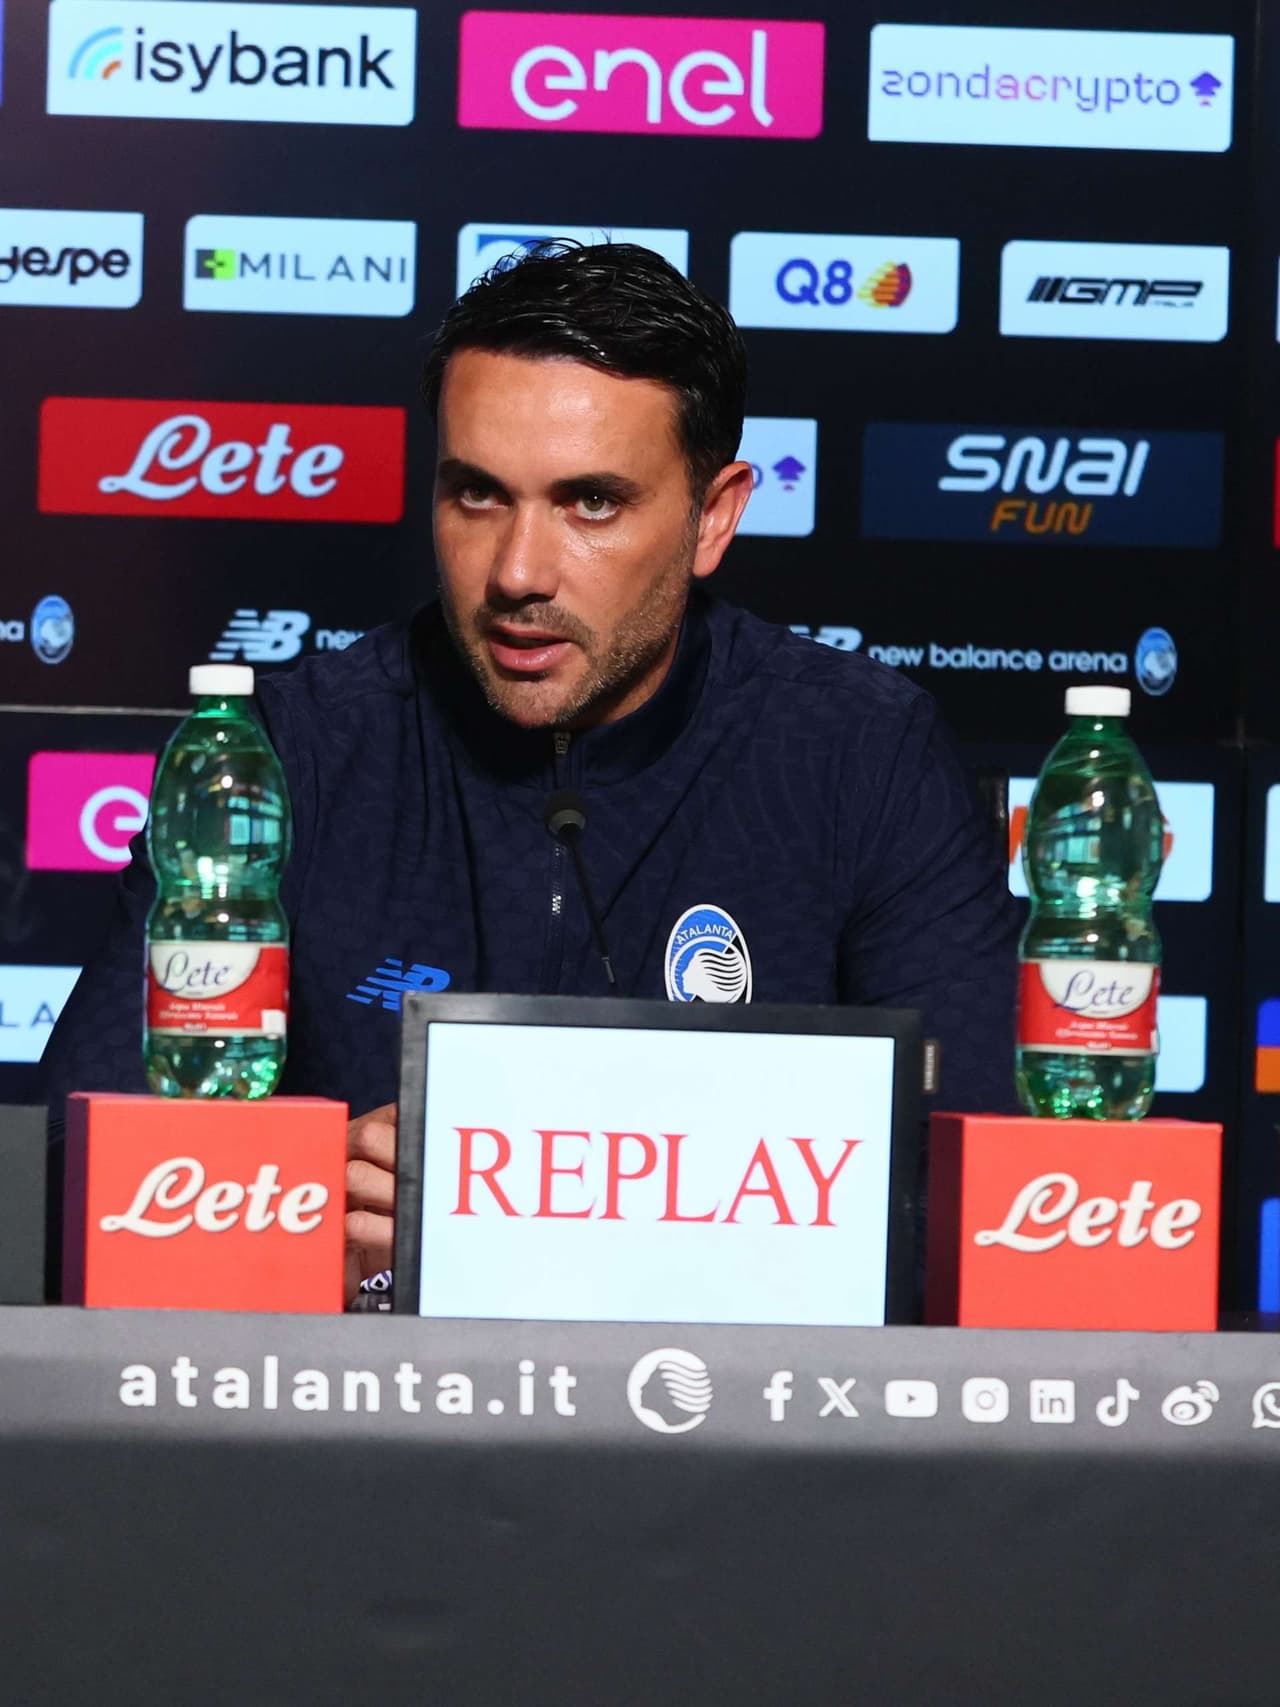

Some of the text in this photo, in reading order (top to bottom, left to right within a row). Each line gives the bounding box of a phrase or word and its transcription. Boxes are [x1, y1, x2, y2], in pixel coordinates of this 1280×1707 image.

[134, 27, 395, 92] isybank
[511, 29, 774, 126] enel
[881, 65, 1181, 112] zondacrypto
[239, 253, 406, 283] MILANI
[776, 258, 853, 305] Q8
[98, 414, 344, 500] Lete
[990, 499, 1093, 535] FUN
[930, 643, 1043, 671] balance
[1050, 650, 1128, 672] arena
[676, 923, 736, 945] ATALANTA
[160, 951, 232, 992] Lete
[1054, 969, 1135, 1012] Lete
[100, 1156, 329, 1238] Lete
[449, 1127, 863, 1227] REPLAY
[974, 1172, 1201, 1253] Lete
[119, 1355, 578, 1416] atalanta.it
